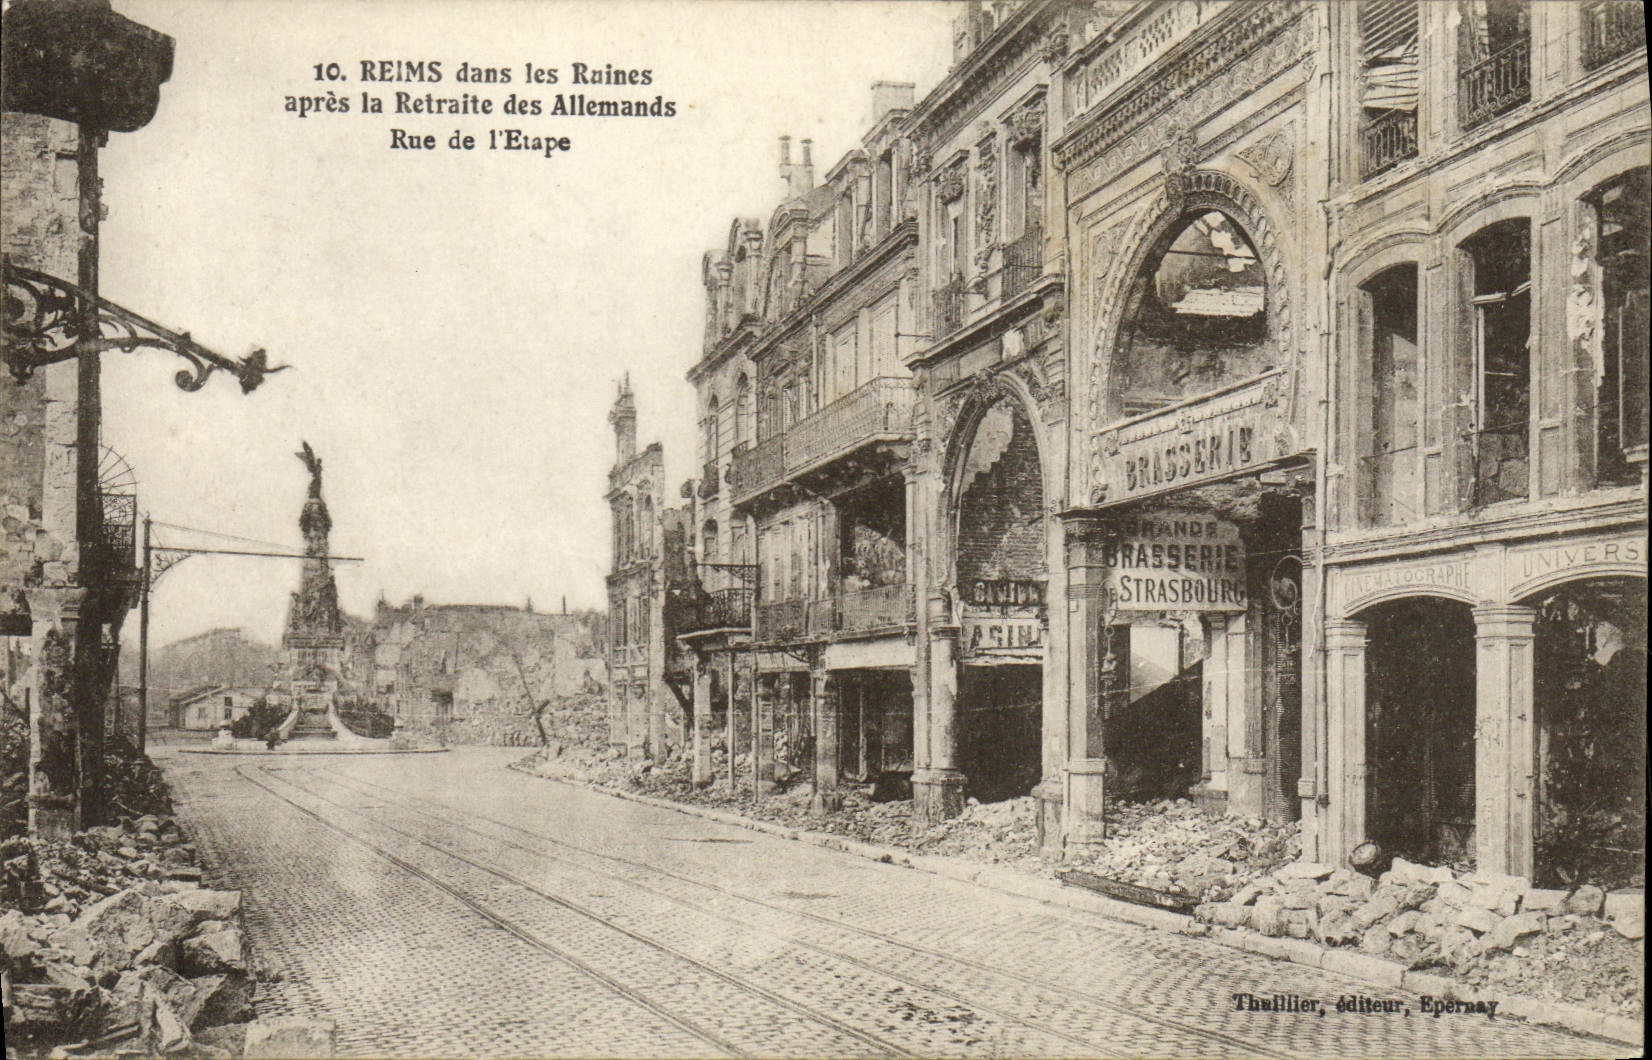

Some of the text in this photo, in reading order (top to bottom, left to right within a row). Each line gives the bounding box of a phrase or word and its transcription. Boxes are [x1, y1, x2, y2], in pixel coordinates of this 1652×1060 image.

[1126, 427, 1252, 491] BRASSERIE
[1104, 543, 1239, 571] BRASSERIE
[1119, 574, 1246, 604] STRASBOURG
[1344, 562, 1471, 601] CINEMATOGRAPHE
